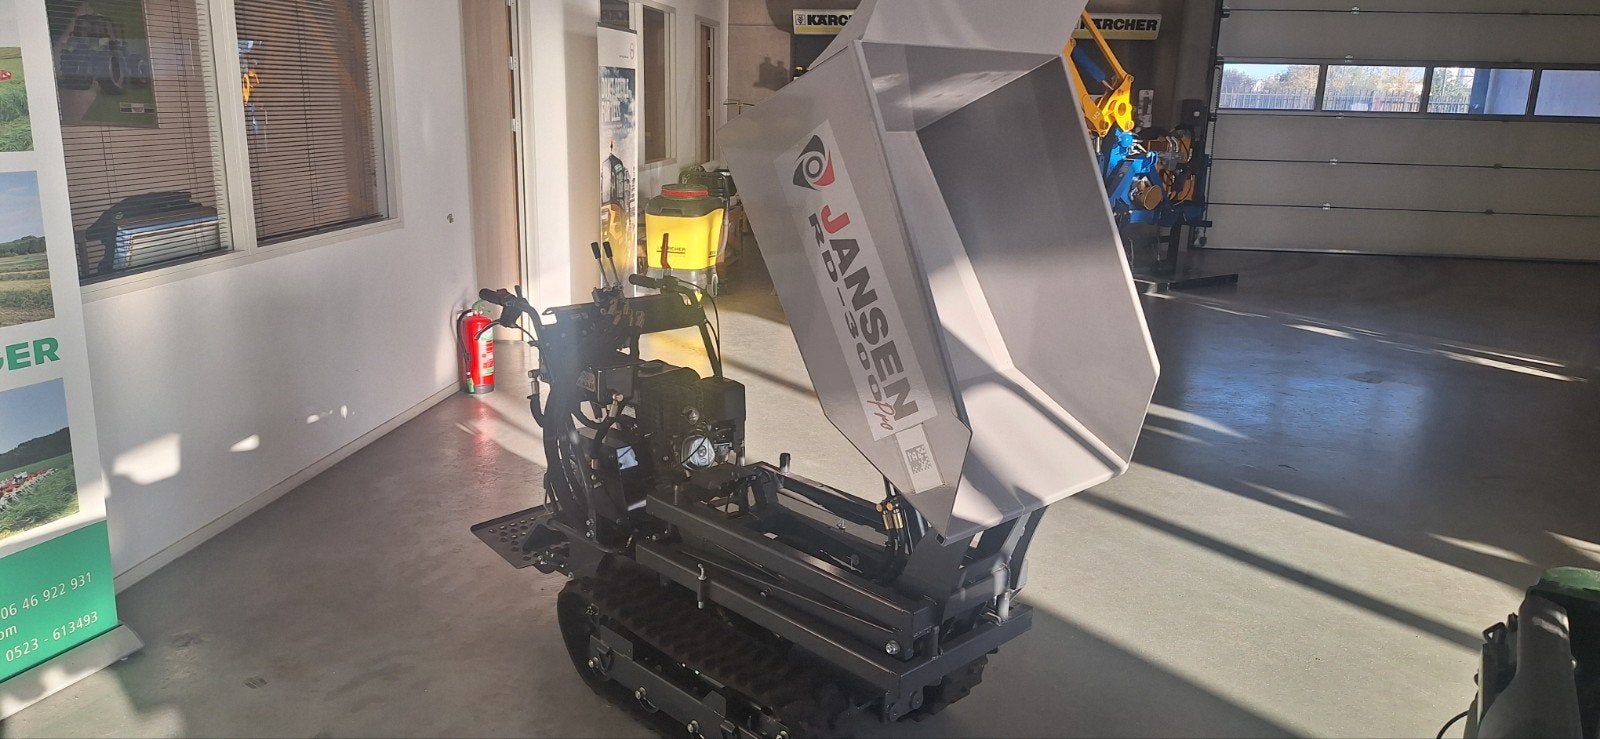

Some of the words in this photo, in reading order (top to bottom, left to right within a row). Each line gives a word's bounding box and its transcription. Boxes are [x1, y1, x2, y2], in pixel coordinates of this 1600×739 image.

[807, 14, 853, 26] KÄRC
[808, 212, 883, 402] RD-300
[866, 400, 895, 431] Pro
[820, 204, 920, 421] JANSEN
[0, 602, 17, 620] 06
[22, 594, 39, 610] 46
[42, 583, 66, 602] 922
[70, 572, 91, 590] 931
[5, 638, 39, 662] 0523
[52, 611, 98, 640] 613493
